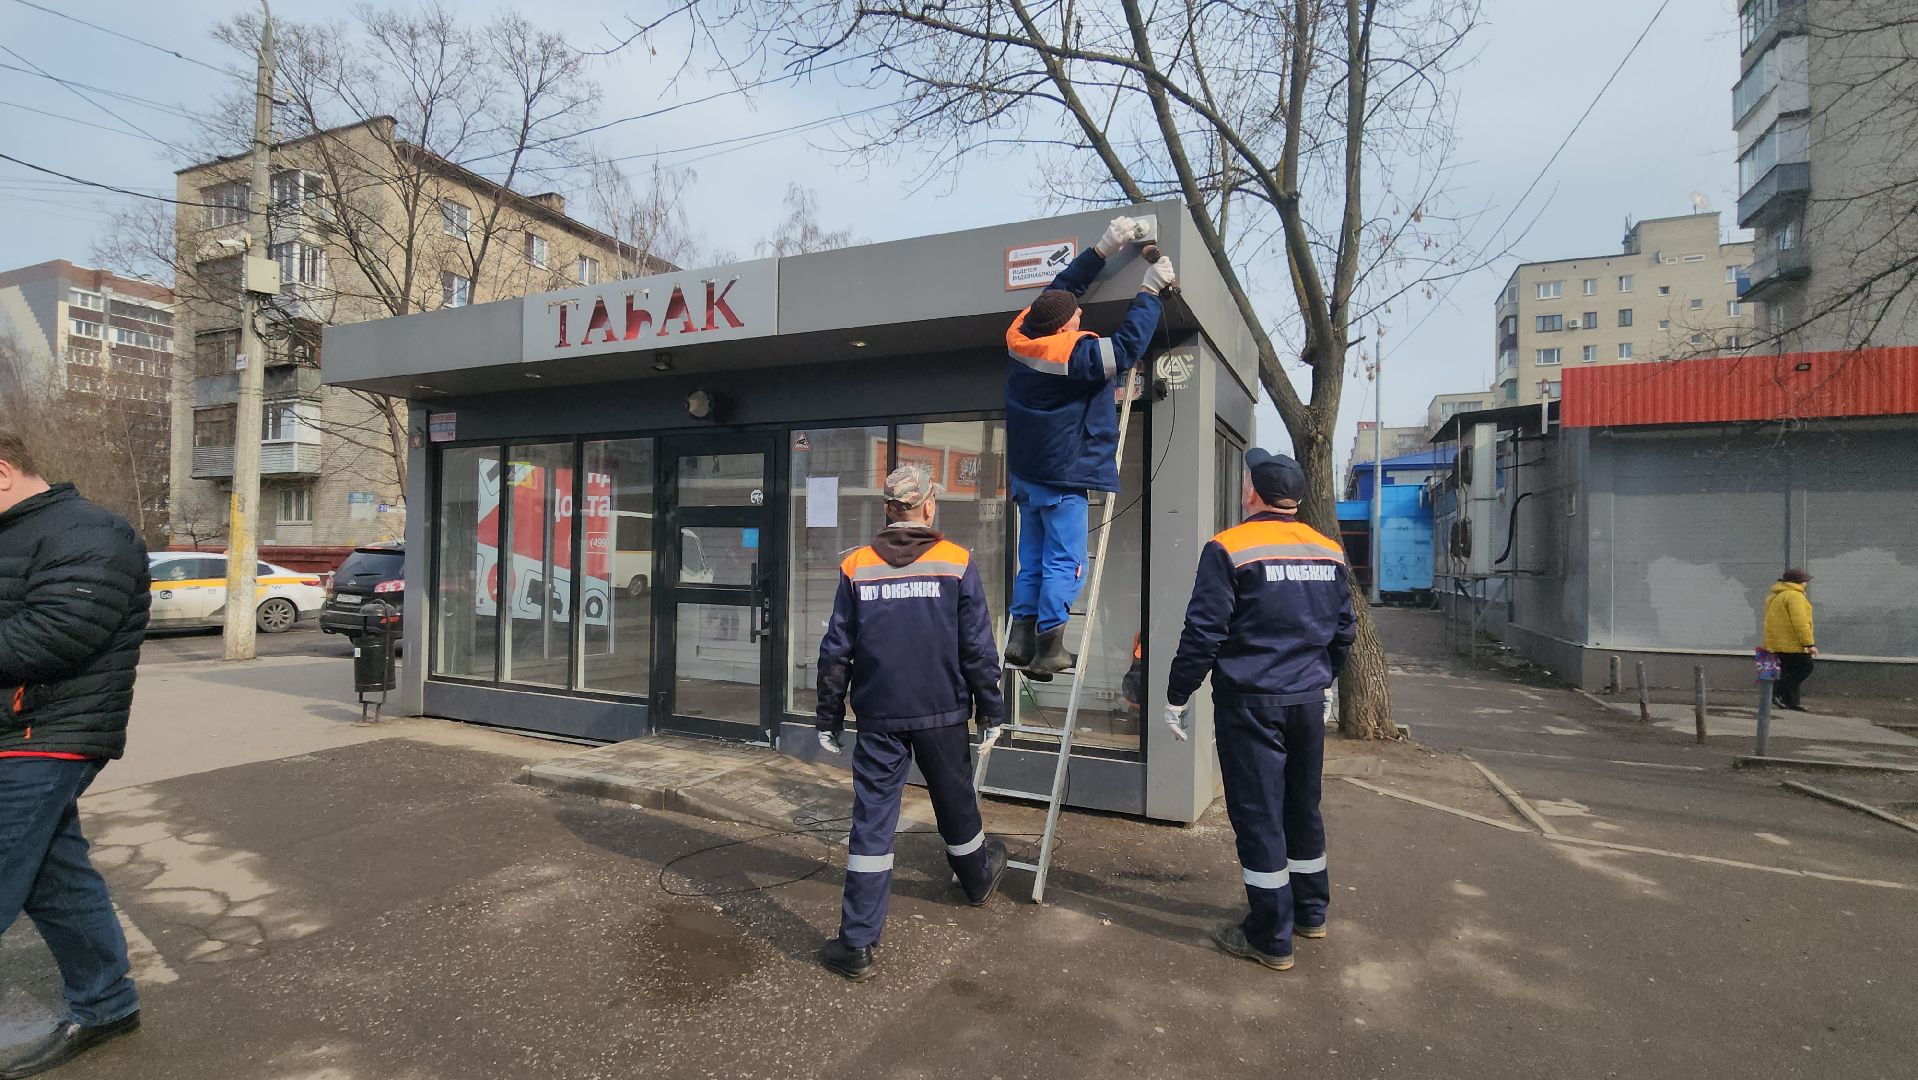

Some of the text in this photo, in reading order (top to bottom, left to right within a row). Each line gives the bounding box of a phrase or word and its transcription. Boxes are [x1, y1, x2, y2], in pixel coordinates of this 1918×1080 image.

[1012, 270, 1060, 280] ВИДЕОНАБЛЮДЕ
[548, 273, 745, 348] ТАБАК
[1265, 565, 1285, 582] МУ
[161, 591, 172, 599] Go
[860, 585, 879, 601] МУ
